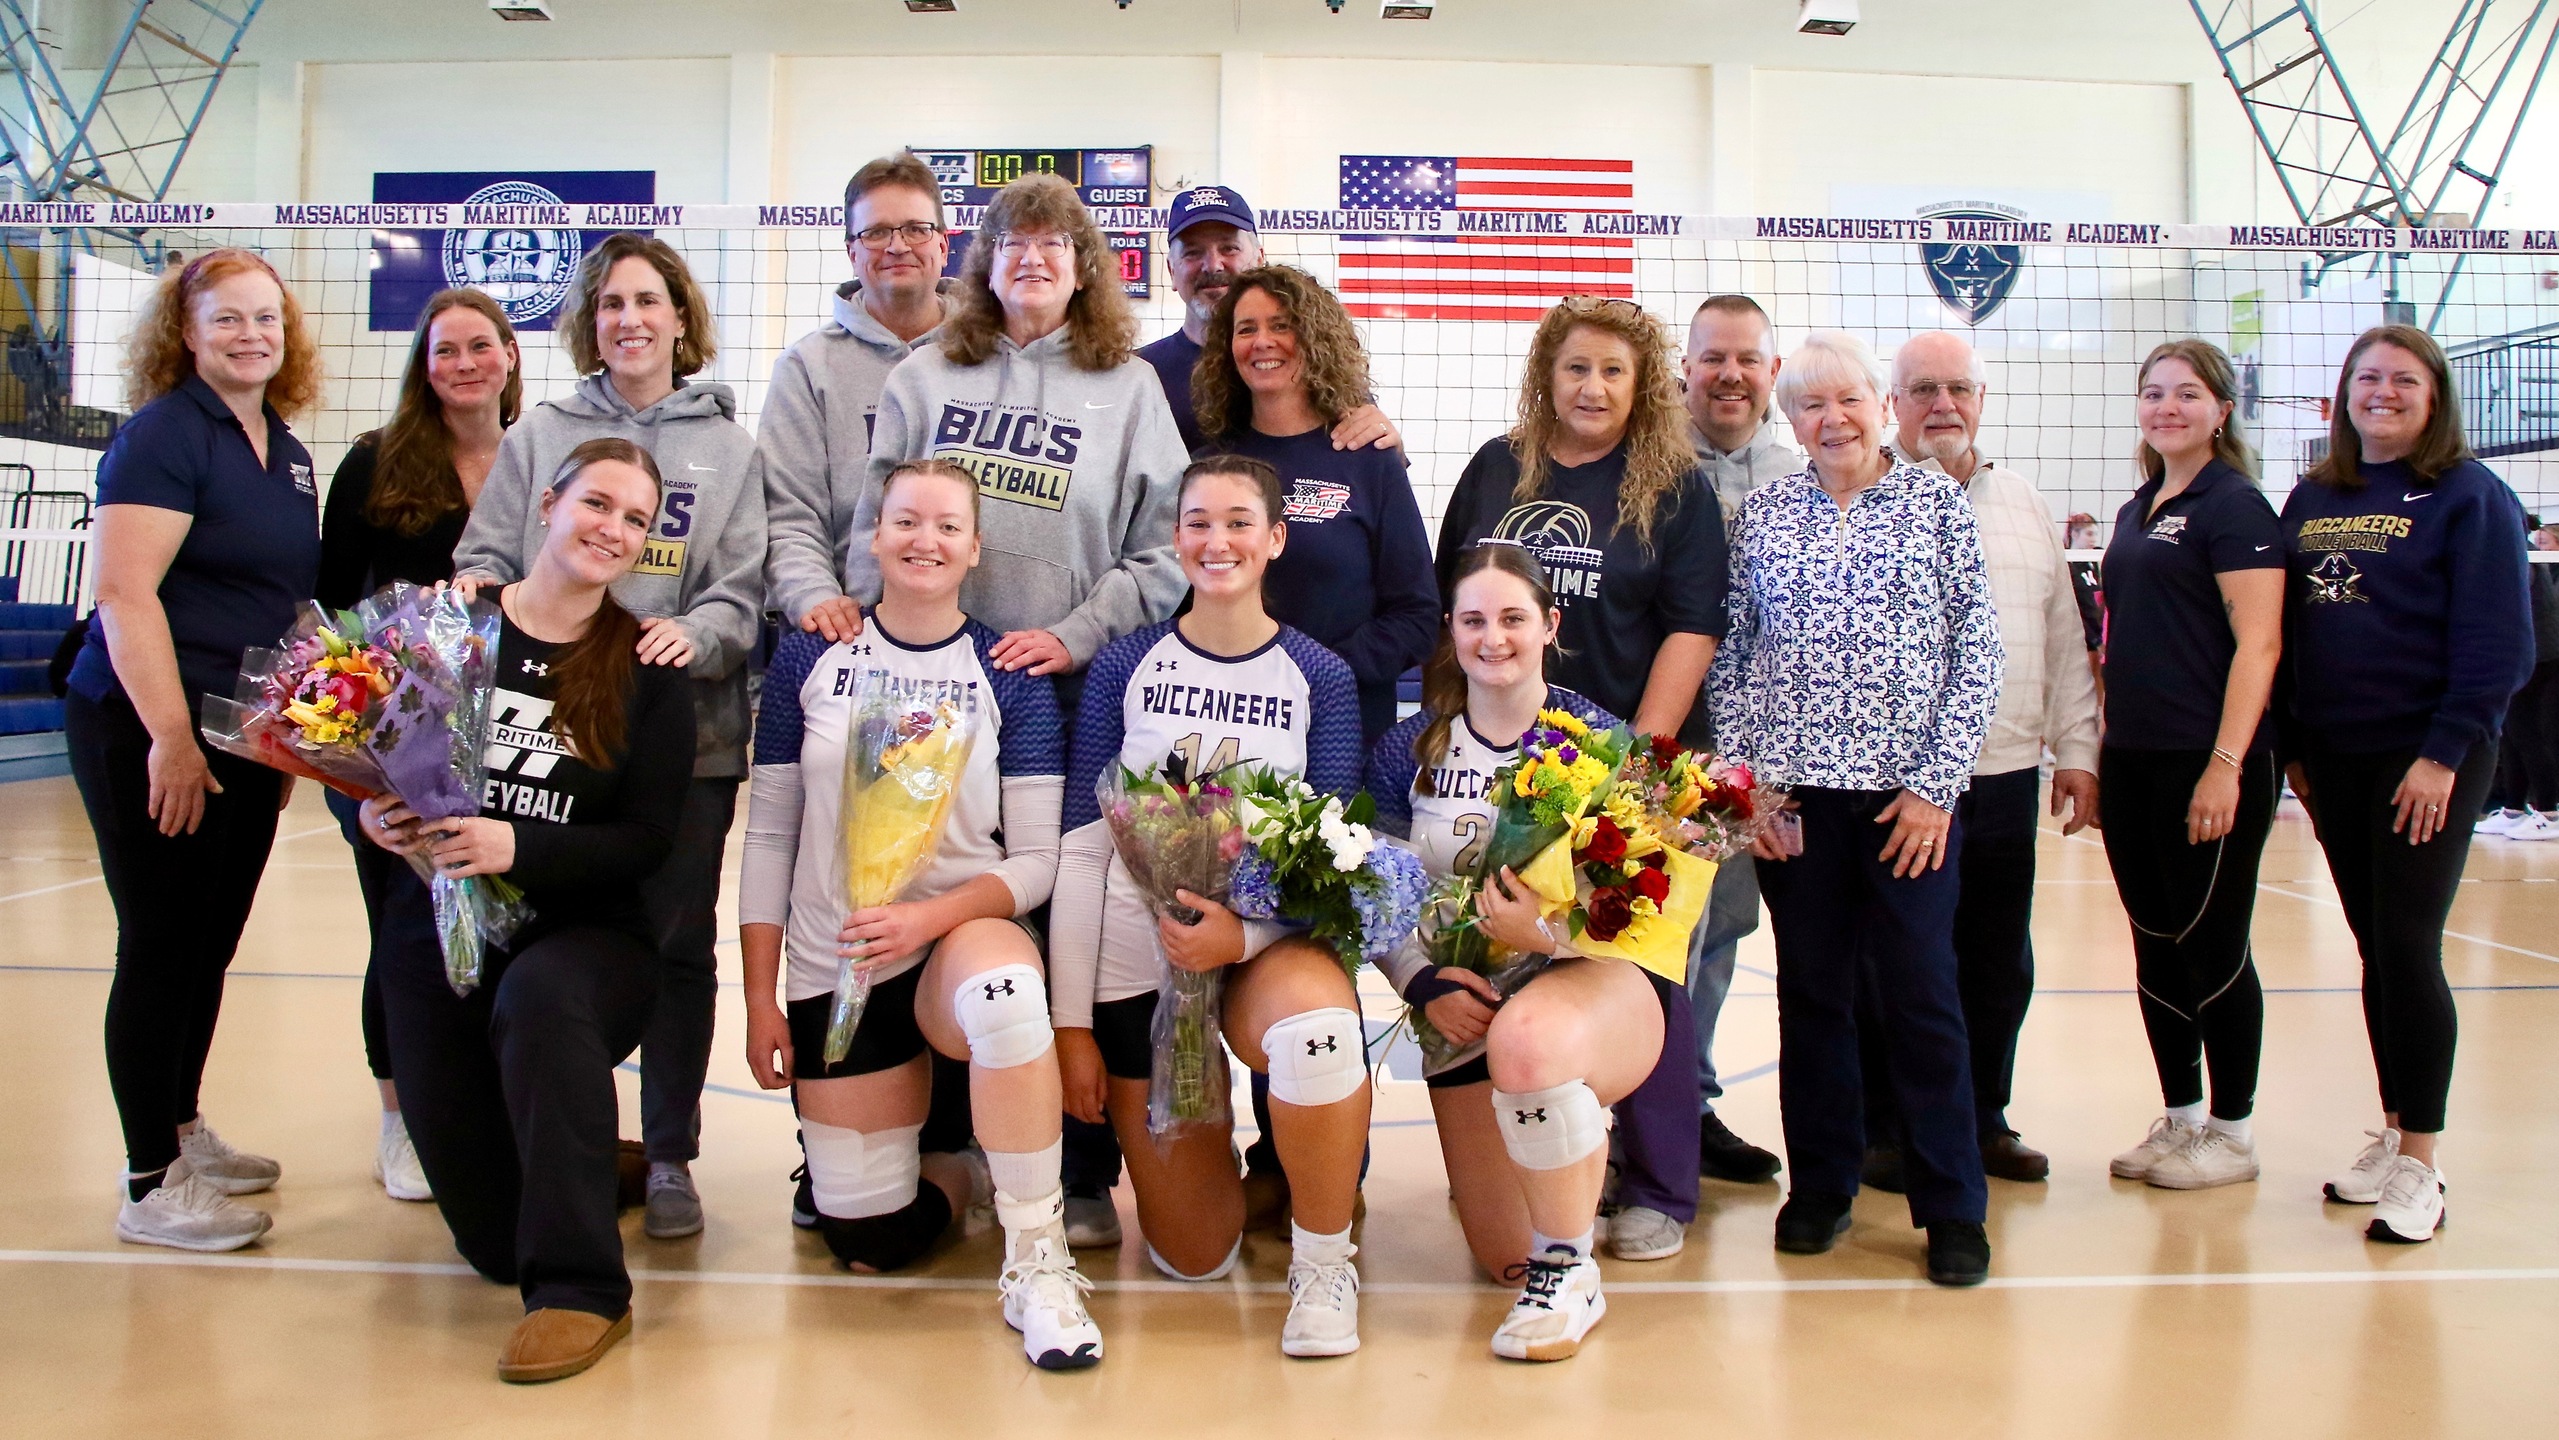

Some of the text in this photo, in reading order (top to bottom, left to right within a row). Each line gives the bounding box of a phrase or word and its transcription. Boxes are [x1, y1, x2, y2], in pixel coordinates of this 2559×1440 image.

[1094, 153, 1134, 164] PEPSI
[941, 189, 965, 203] CS
[1090, 189, 1147, 203] GUEST
[109, 204, 204, 224] ACADEMY
[275, 204, 684, 226] MASSACHUSETTS MARITIME ACADEMY
[1259, 209, 1683, 236] MASSACHUSETTS MARITIME ACADEMY
[1756, 217, 2160, 244] MASSACHUSETTS MARITIME ACADEMY
[2230, 226, 2396, 248] MASSACHUSETTS
[2410, 228, 2510, 249] MARITIME
[1110, 237, 1147, 248] FOULS
[1121, 249, 1142, 280] 0
[935, 403, 1082, 465] BUCS
[663, 479, 698, 490] ACADEMY
[1294, 478, 1351, 492] MASSACHUSETTS
[1294, 497, 1343, 509] MARITIME
[1288, 515, 1325, 524] ACADEMY
[2298, 514, 2412, 538] BUCCANEERS
[2298, 532, 2388, 553] VOLLEYBALL
[495, 727, 566, 753] RITIME
[1173, 732, 1241, 786] 14
[483, 778, 574, 825] EYBALL
